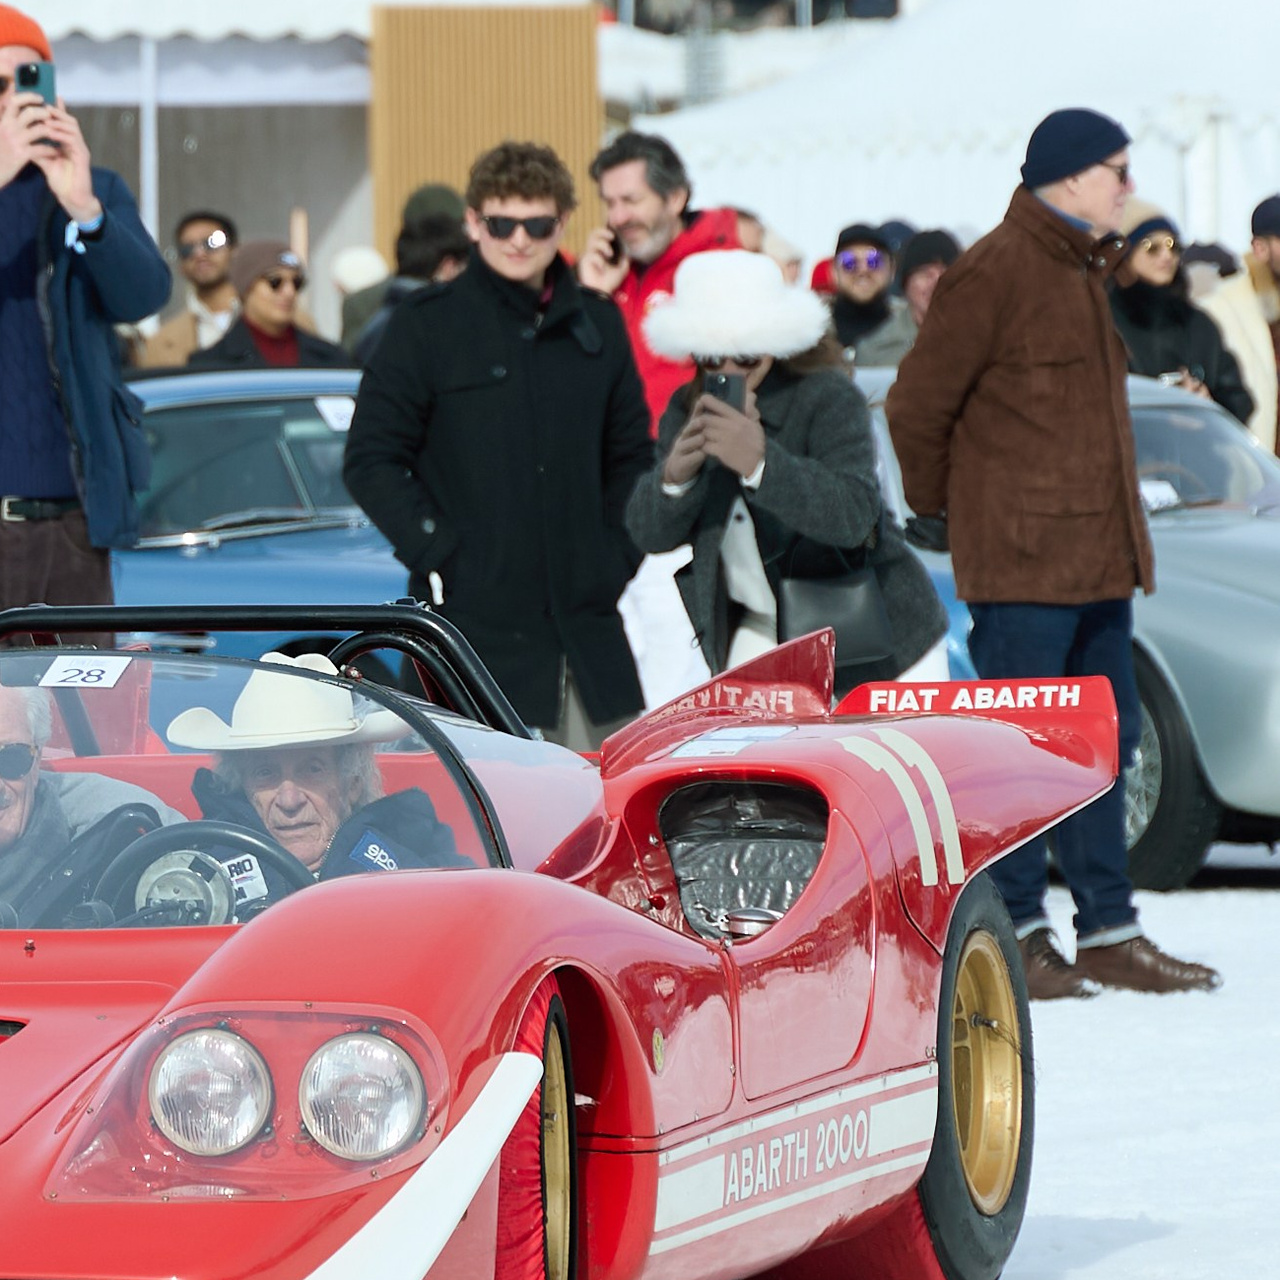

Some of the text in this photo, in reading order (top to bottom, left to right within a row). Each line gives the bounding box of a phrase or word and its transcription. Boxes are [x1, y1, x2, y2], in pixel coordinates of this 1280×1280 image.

[57, 668, 106, 683] 28
[870, 685, 1080, 712] FIAT ABARTH
[725, 1109, 869, 1206] ABARTH 2000
